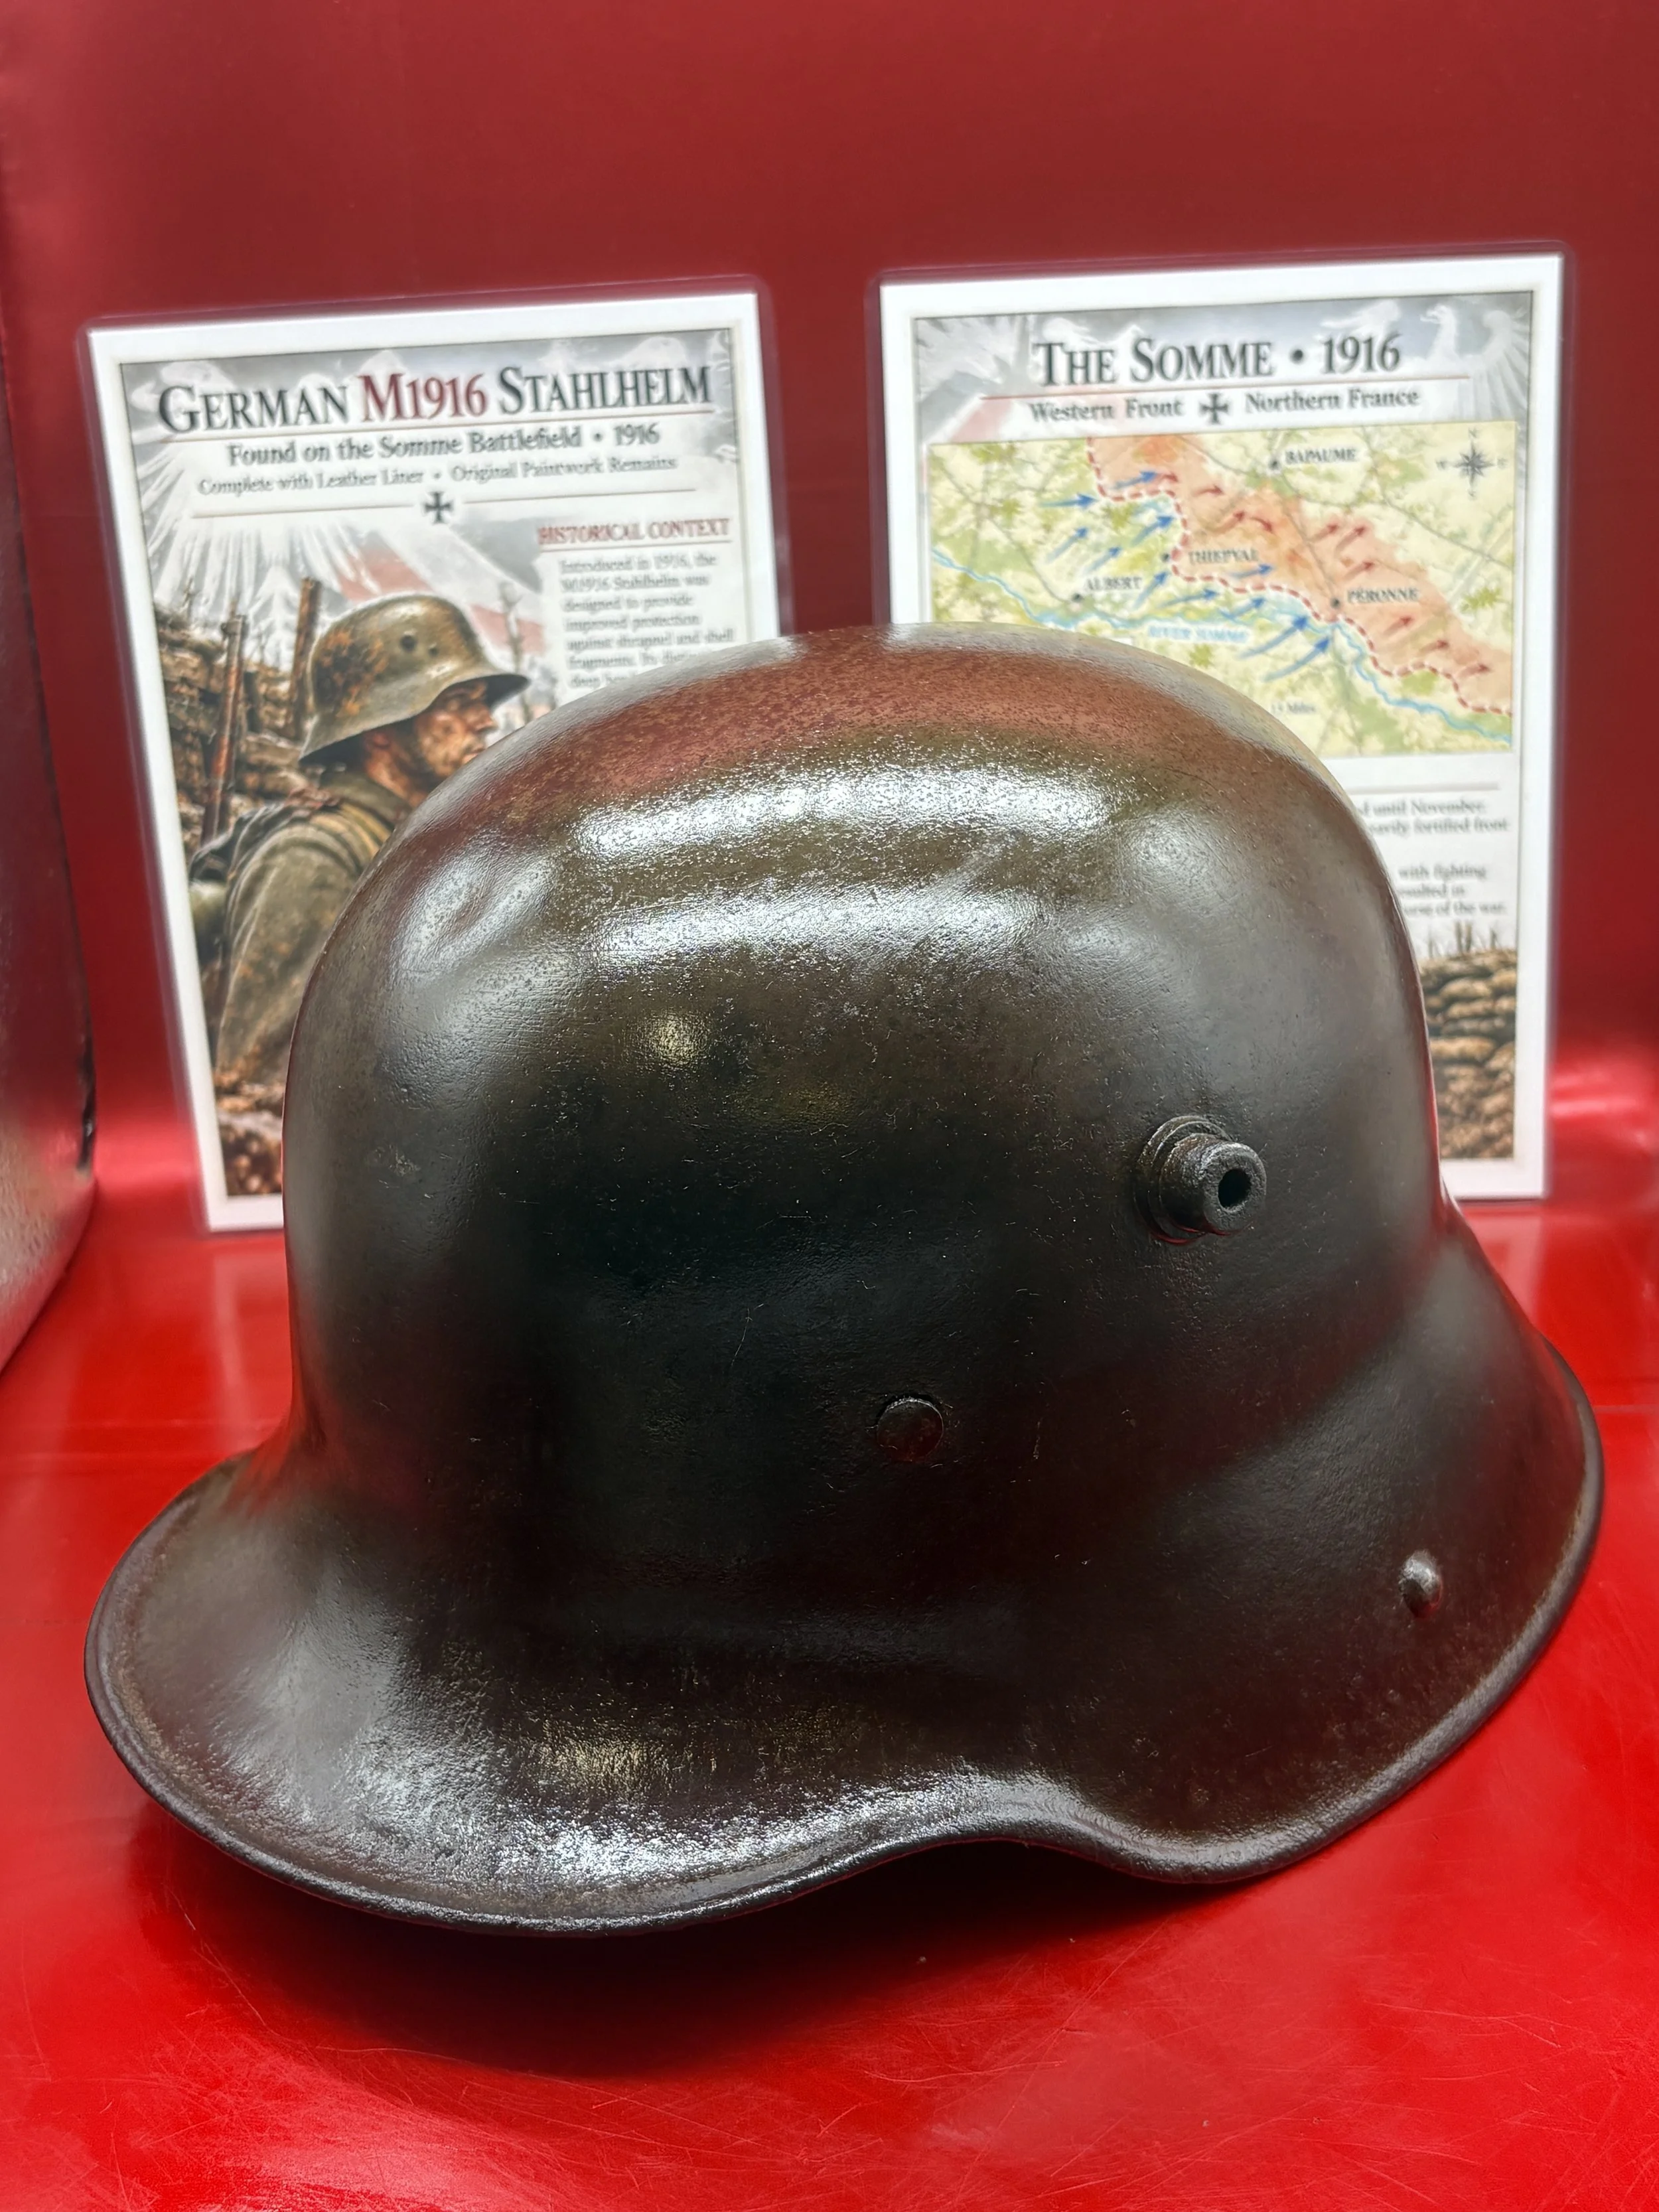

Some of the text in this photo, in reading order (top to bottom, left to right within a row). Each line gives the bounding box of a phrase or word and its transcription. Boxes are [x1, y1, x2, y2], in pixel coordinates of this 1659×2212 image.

[1032, 332, 1402, 388] THE SOMME 1916
[159, 365, 713, 434] GERMAN M1916 STAHLHELM
[1028, 398, 1183, 423] Western Front
[1245, 386, 1420, 413] Northern France
[227, 421, 662, 467] Found on the Somme Battlefield 1916
[1285, 448, 1358, 464] BAPAUME
[198, 455, 679, 497] Complete with Leather Liner Original Paintwork Remains
[538, 518, 731, 546] HISTORICAL CONTEXT
[612, 573, 682, 591] Stahlhelm
[1085, 576, 1143, 591] ALBERT
[632, 613, 701, 632] protection
[1372, 800, 1406, 817] until
[1368, 819, 1409, 836] eavily
[1398, 863, 1487, 882] with fighting
